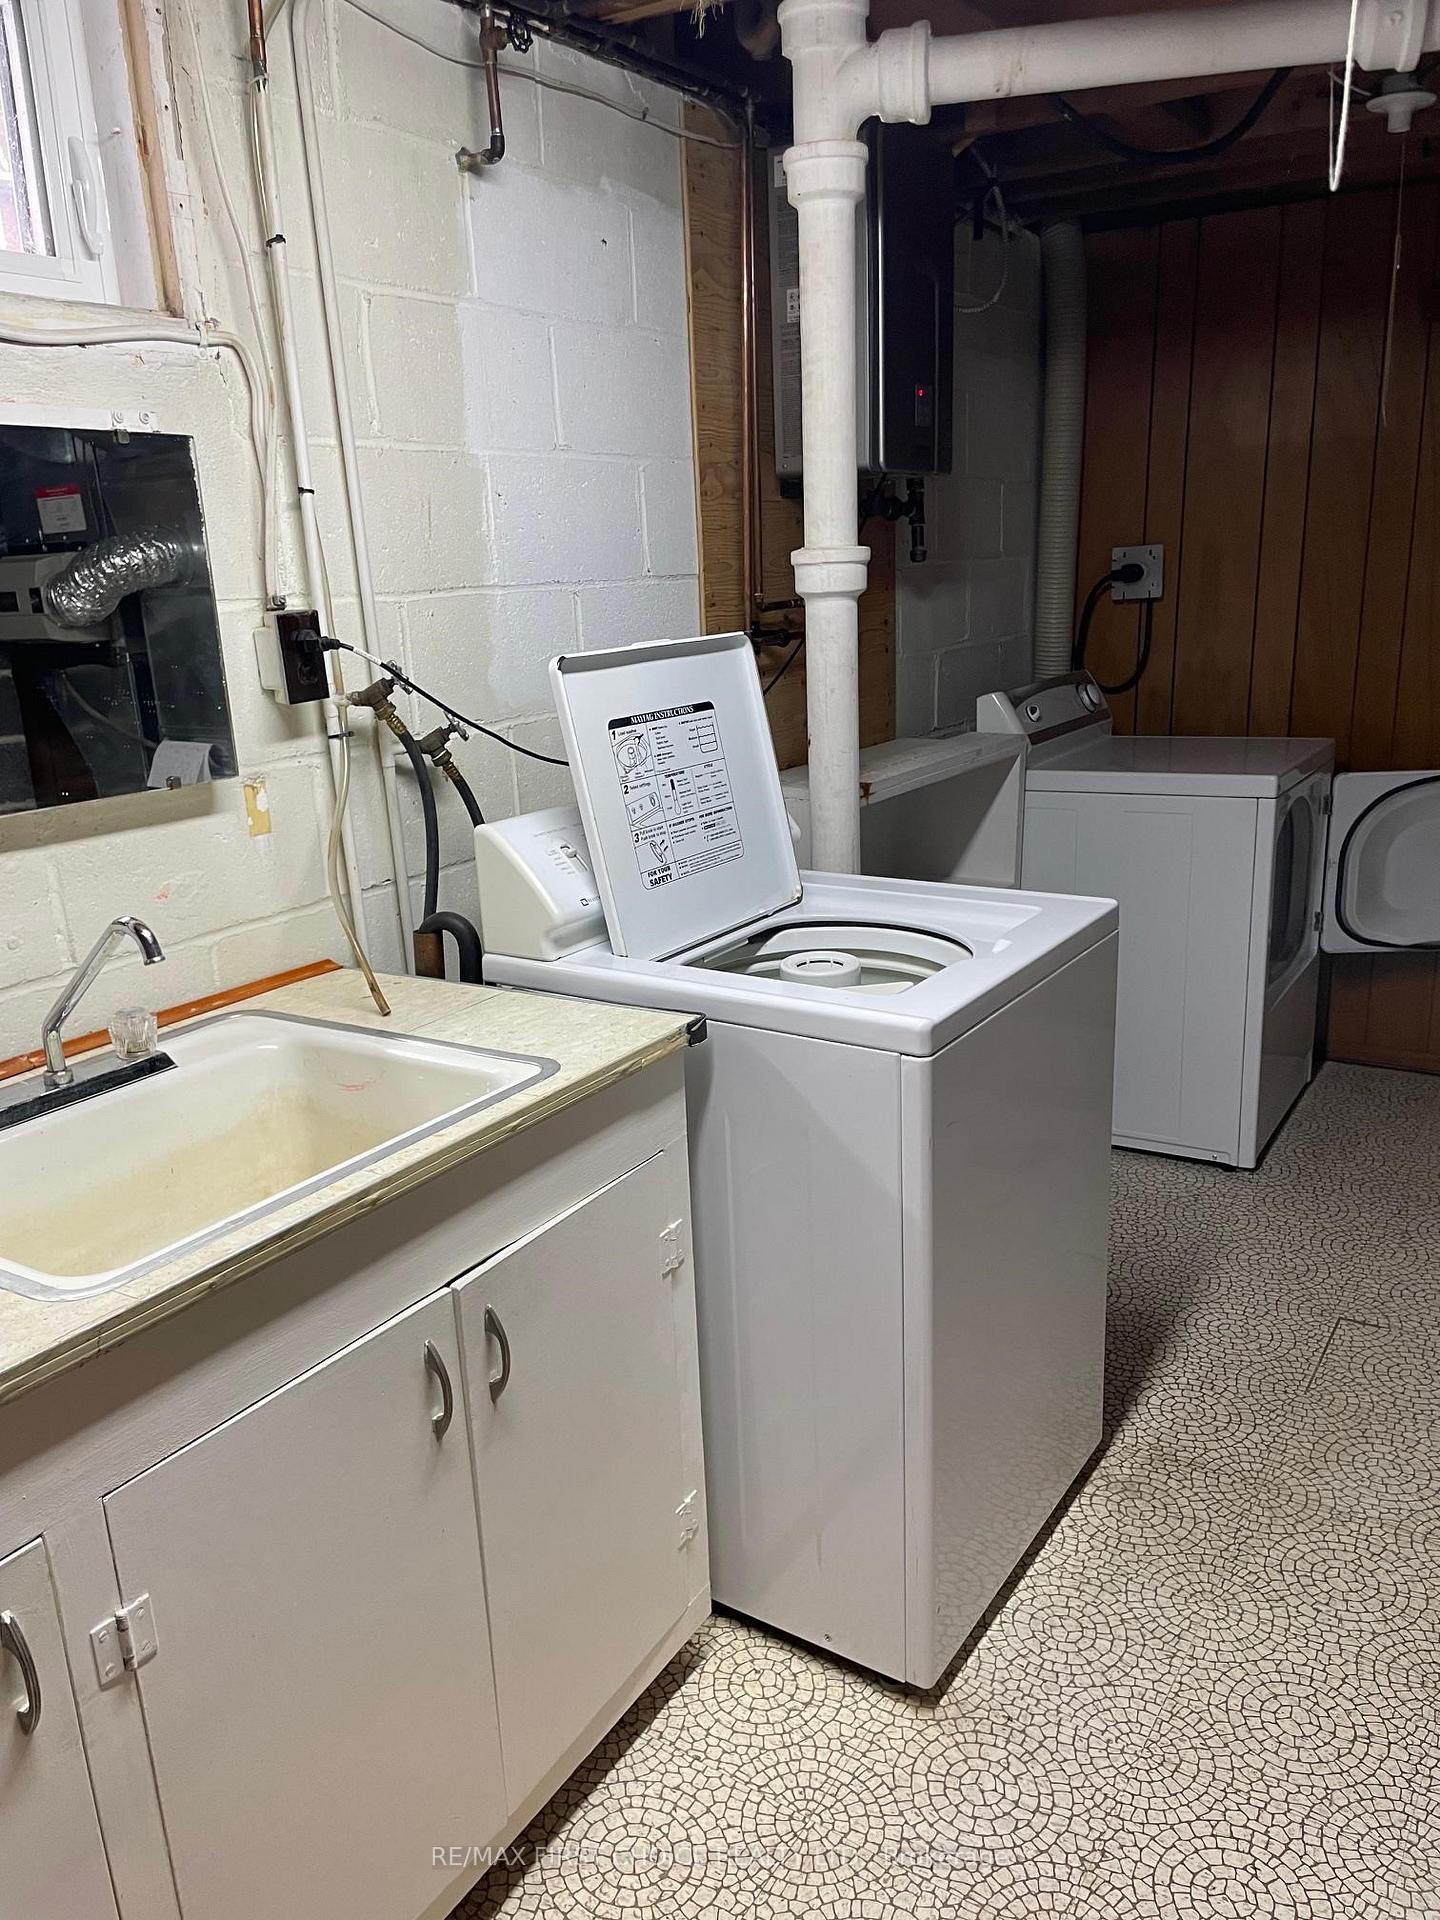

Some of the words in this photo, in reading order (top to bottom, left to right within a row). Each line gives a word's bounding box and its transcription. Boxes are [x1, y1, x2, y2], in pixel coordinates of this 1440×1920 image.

[630, 713, 654, 724] MAYTAG
[653, 706, 694, 720] INSTRUCTIONS
[623, 784, 630, 795] 2
[634, 832, 640, 843] 3
[647, 870, 657, 878] FOR
[658, 866, 671, 875] YOUR
[649, 872, 673, 887] SAFETY
